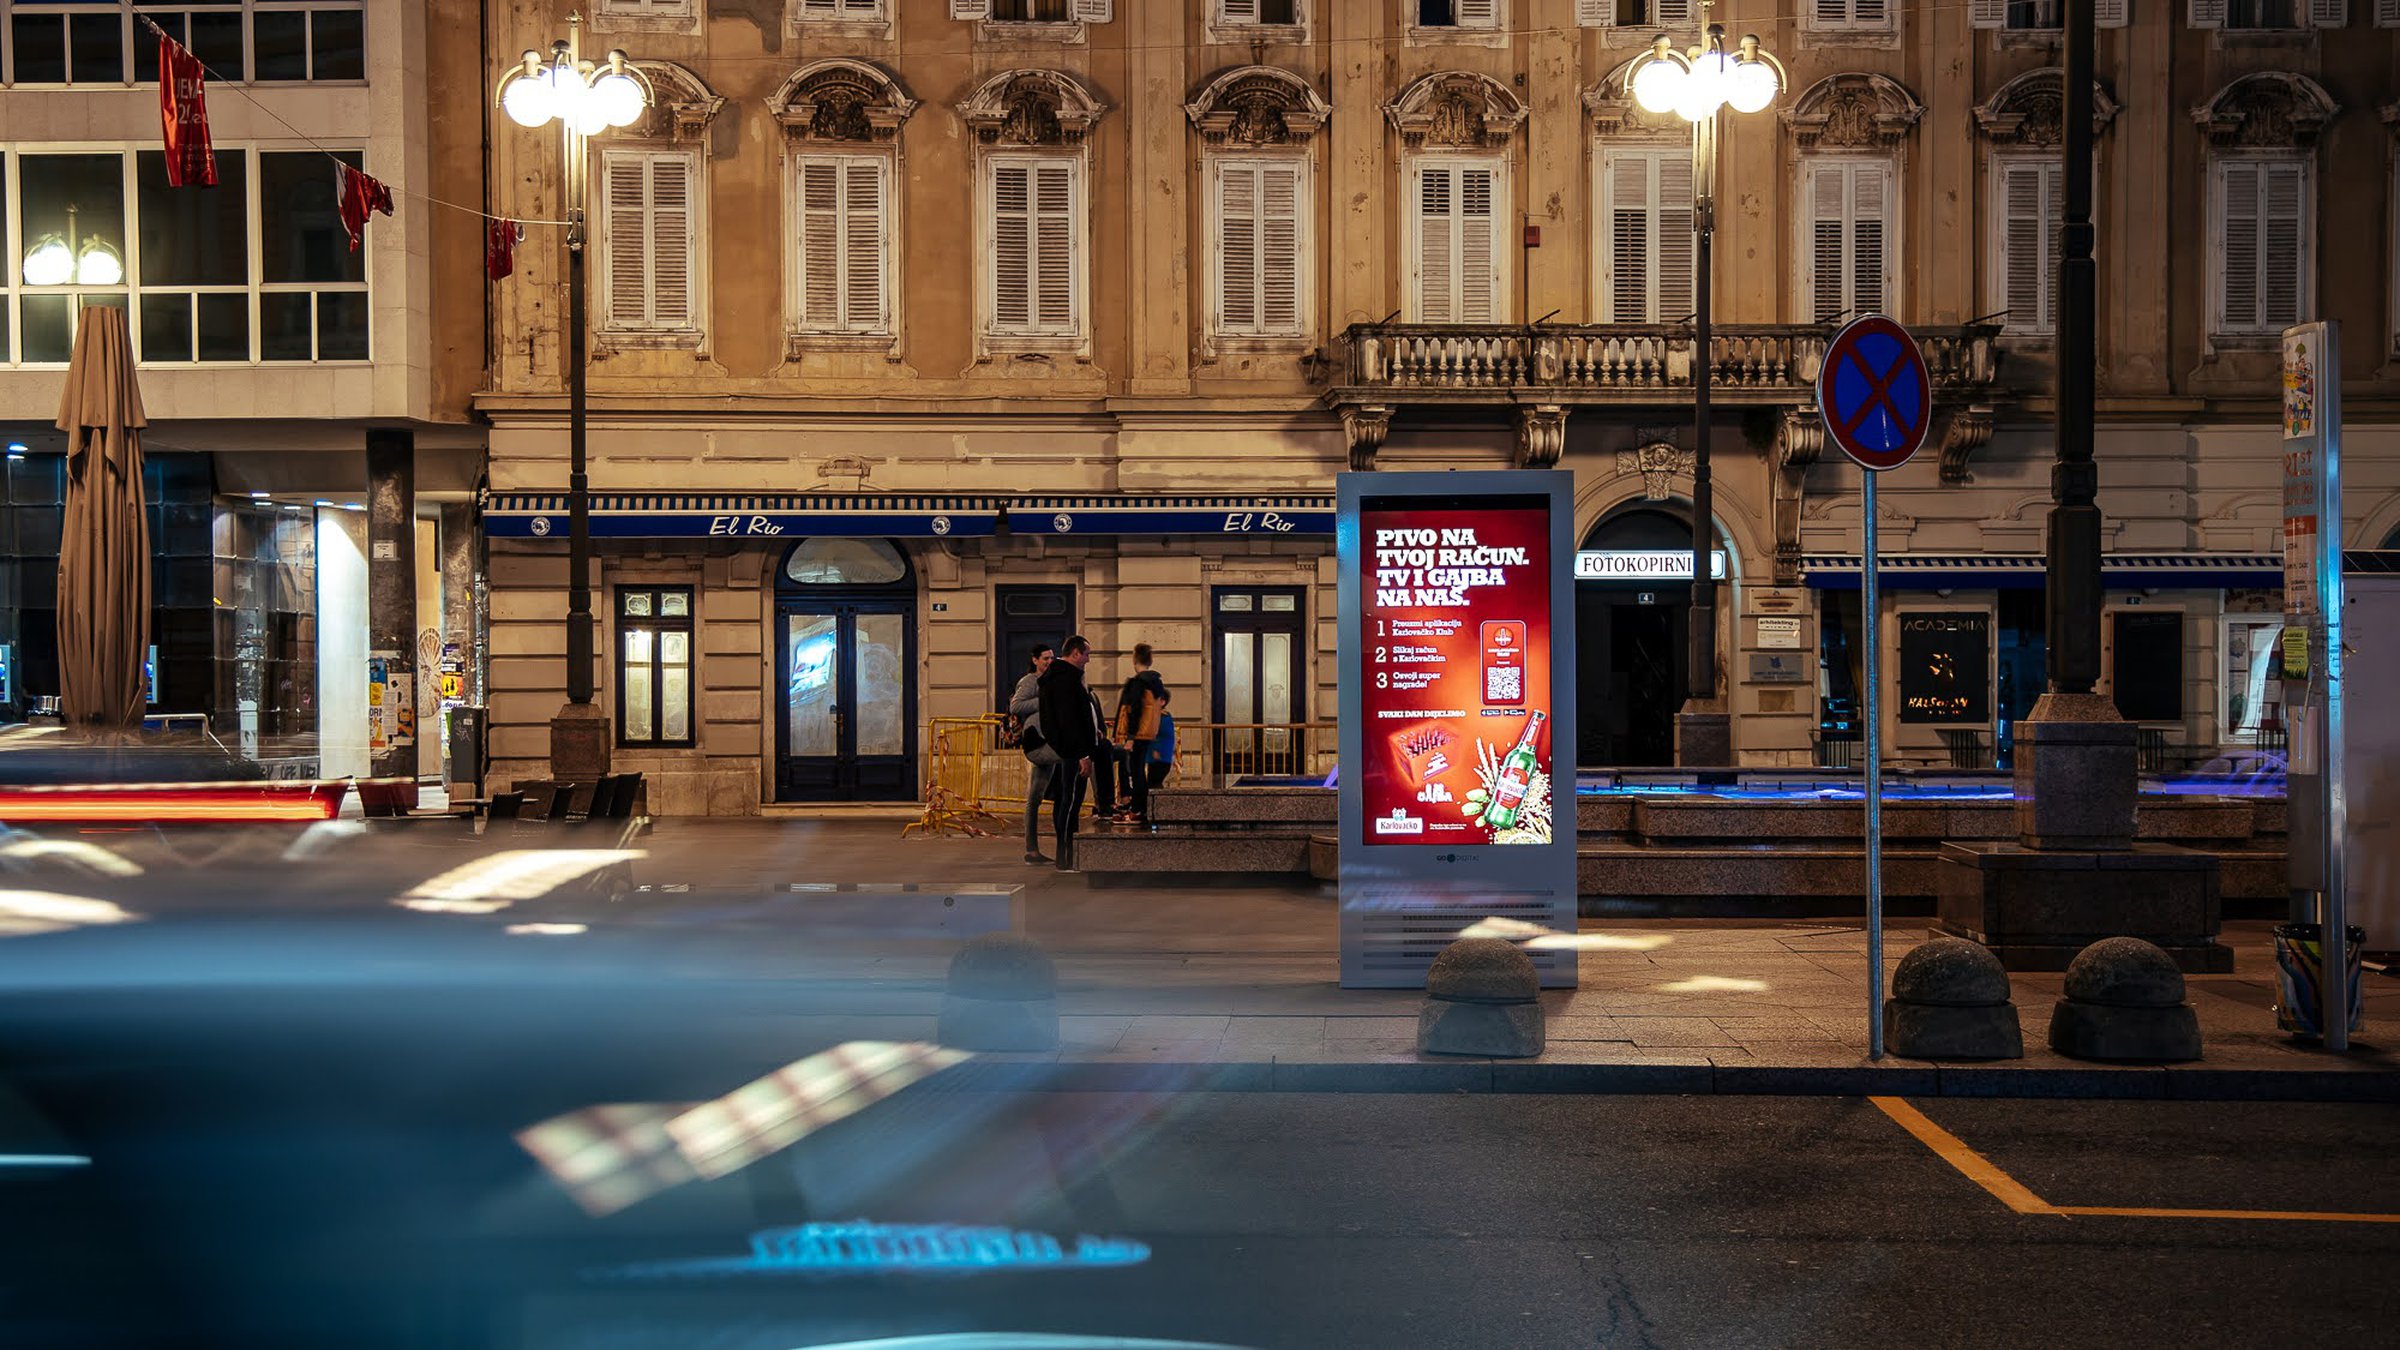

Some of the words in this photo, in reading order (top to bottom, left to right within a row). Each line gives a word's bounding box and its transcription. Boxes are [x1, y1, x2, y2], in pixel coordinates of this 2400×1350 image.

[709, 516, 740, 535] El
[746, 515, 785, 535] Rio
[1223, 513, 1253, 532] El
[1260, 512, 1296, 532] Rio
[1376, 529, 1438, 546] PIVO
[1440, 529, 1477, 546] NA
[1376, 549, 1435, 570] TVOJ
[1438, 546, 1530, 566] RAČUN.
[1583, 556, 1713, 573] FOTOKOPIRNI
[1376, 569, 1412, 587] TV
[1413, 569, 1425, 586] I
[1427, 568, 1506, 590] GAJBA
[1376, 589, 1412, 607] NA
[1414, 586, 1471, 607] NAŠ.
[1377, 620, 1386, 637] 1
[1904, 619, 1986, 631] ACADEMIA
[1375, 646, 1387, 663] 2
[1376, 672, 1388, 689] 3
